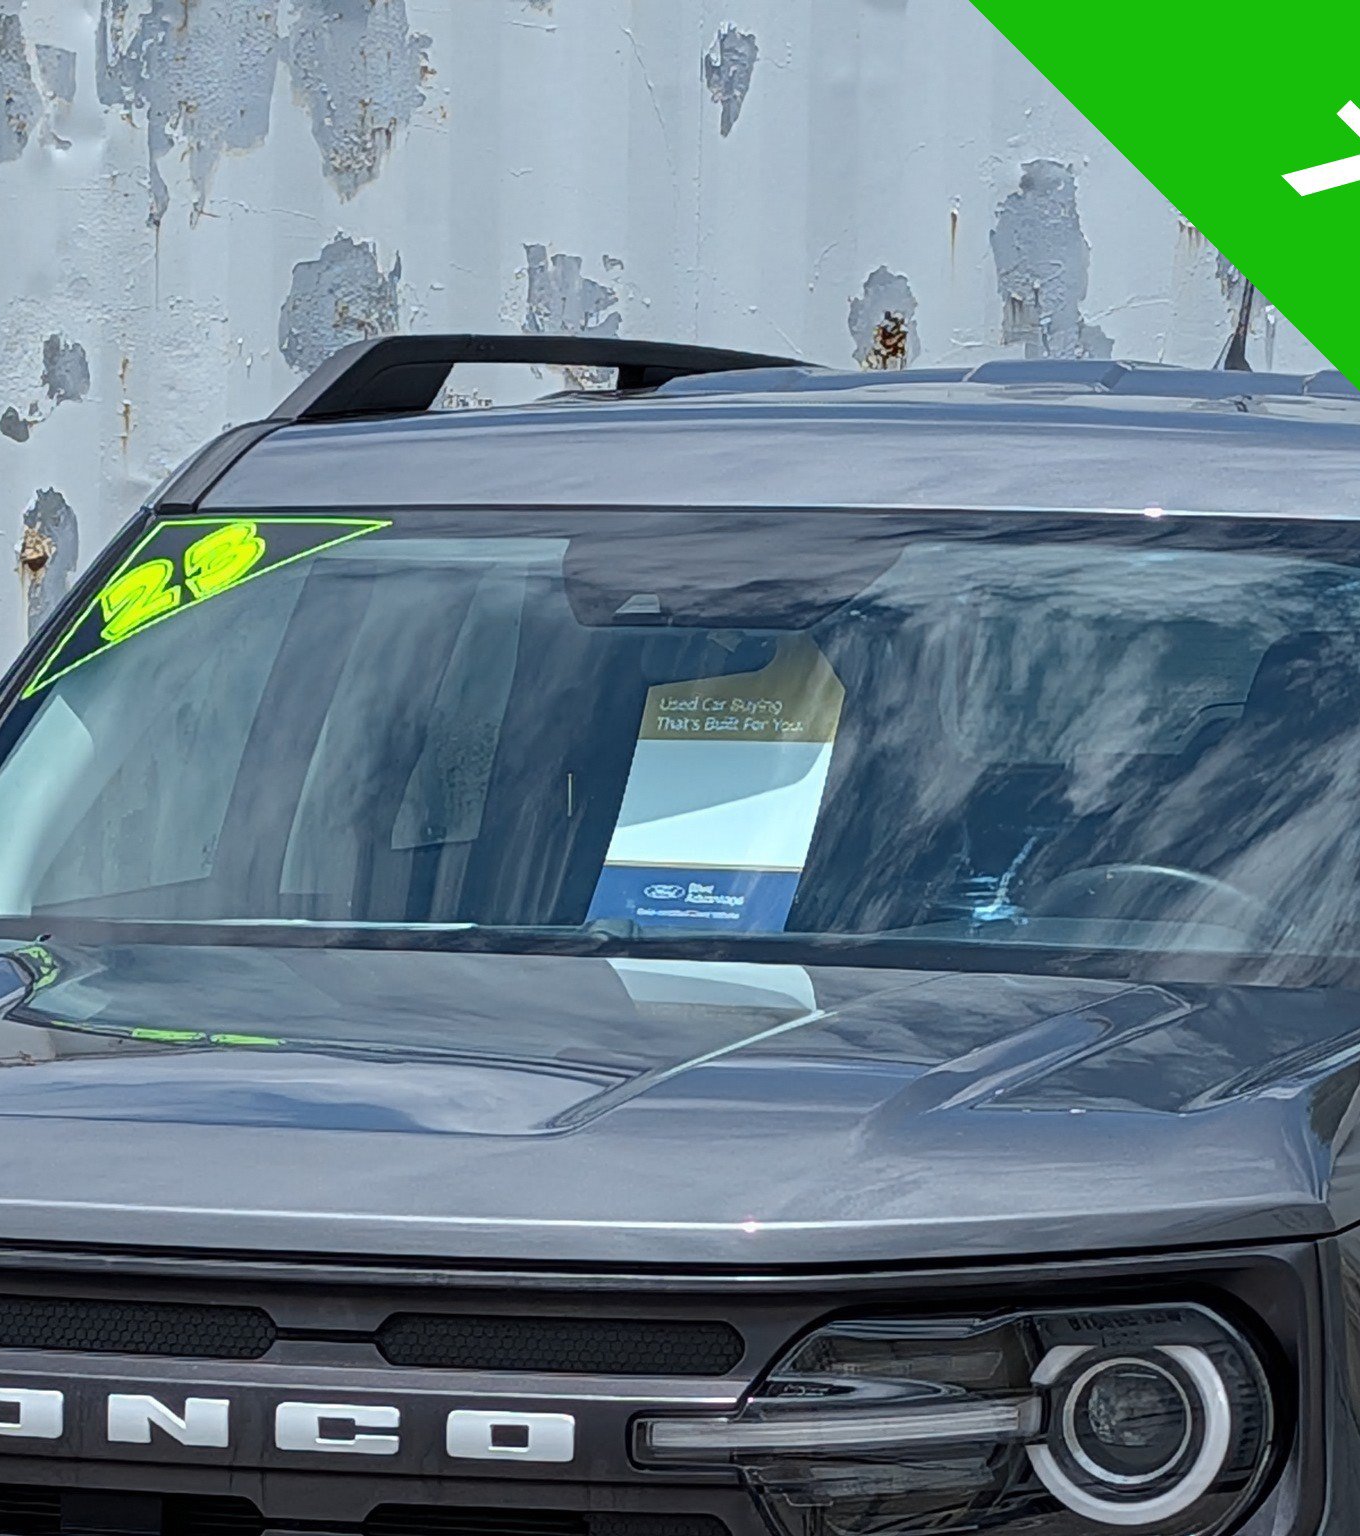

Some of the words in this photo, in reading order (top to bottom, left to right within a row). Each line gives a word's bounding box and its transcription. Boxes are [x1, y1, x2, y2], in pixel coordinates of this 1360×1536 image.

[100, 521, 266, 642] 23
[659, 696, 698, 712] Used
[702, 698, 725, 712] Car
[657, 716, 701, 732] That's
[743, 717, 769, 732] For
